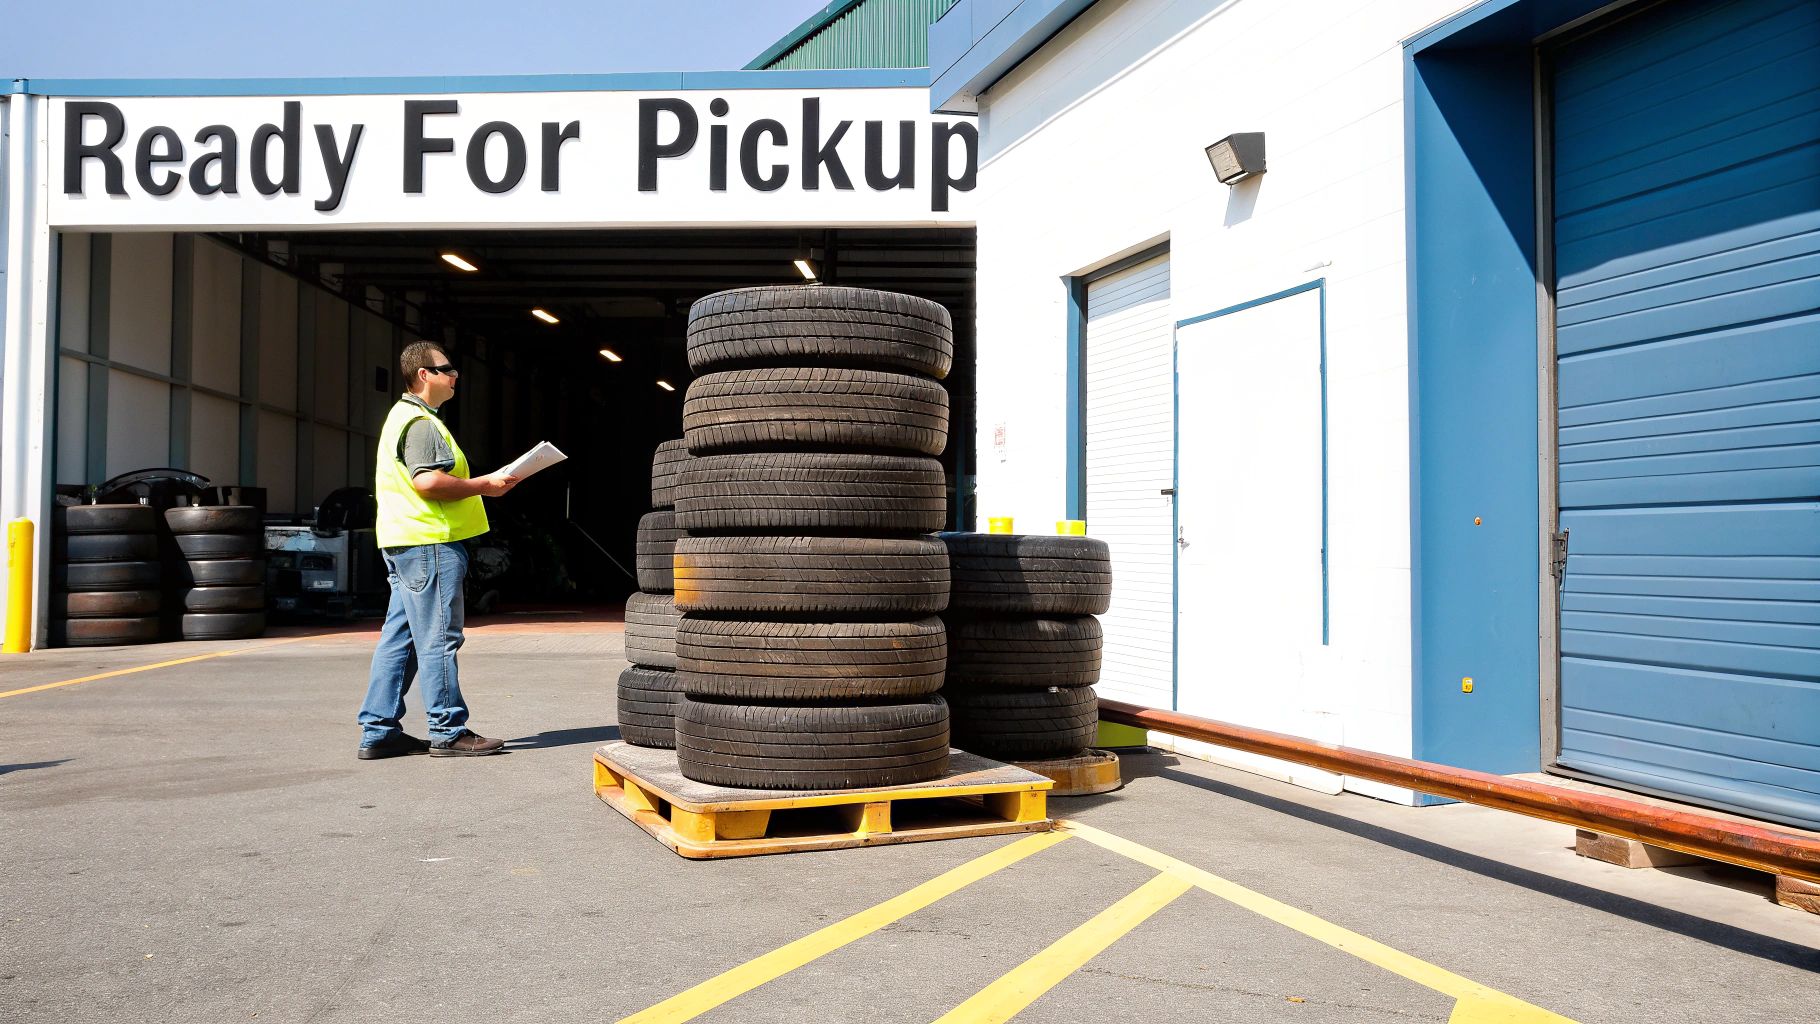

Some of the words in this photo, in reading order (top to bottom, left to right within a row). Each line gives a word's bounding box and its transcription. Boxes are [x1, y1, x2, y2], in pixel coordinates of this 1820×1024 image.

[64, 101, 364, 211] Ready
[403, 100, 580, 194] For
[638, 97, 978, 212] Pickup
